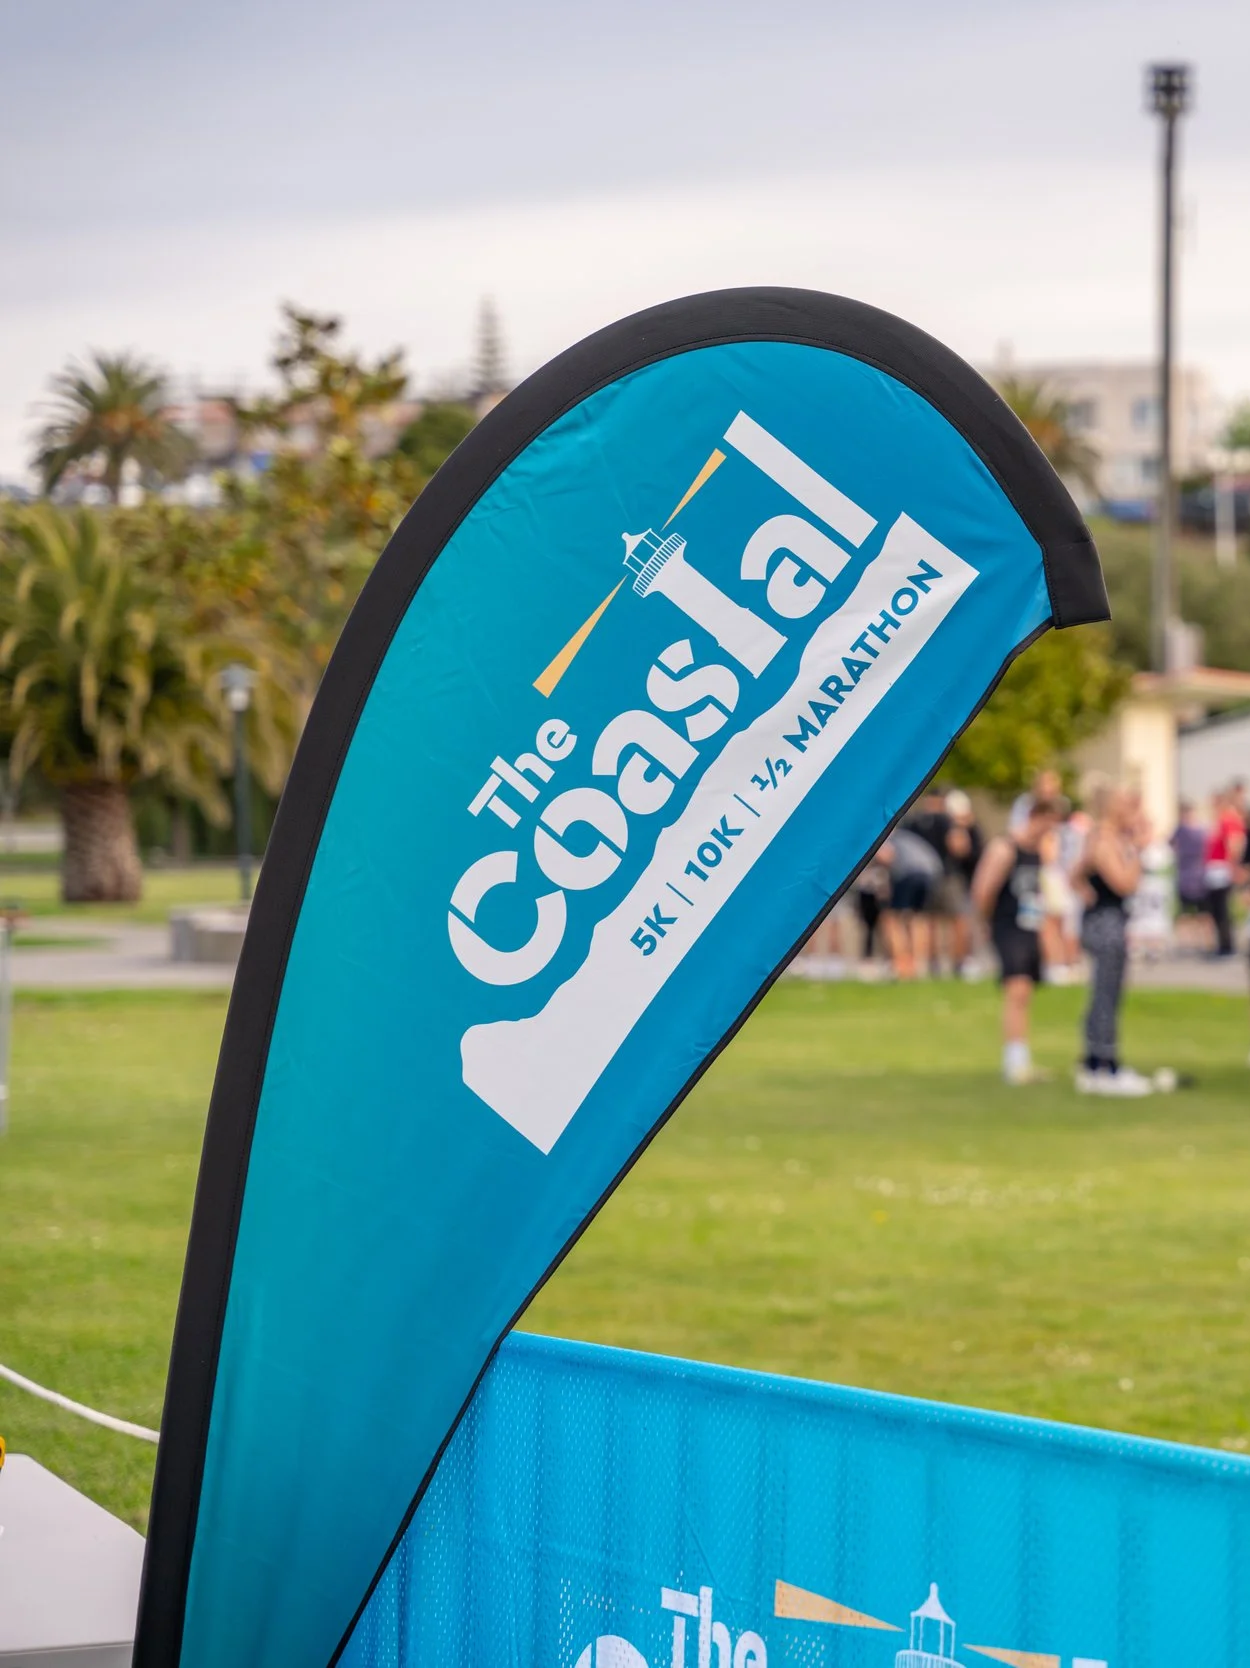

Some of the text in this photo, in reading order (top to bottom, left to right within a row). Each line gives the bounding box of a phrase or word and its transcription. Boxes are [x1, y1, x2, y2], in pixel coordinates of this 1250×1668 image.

[447, 410, 878, 986] Coastal
[467, 718, 578, 829] The
[630, 903, 678, 956] 5K
[684, 814, 744, 882] 10K
[782, 559, 943, 753] MARATHON
[661, 1585, 767, 1668] The
